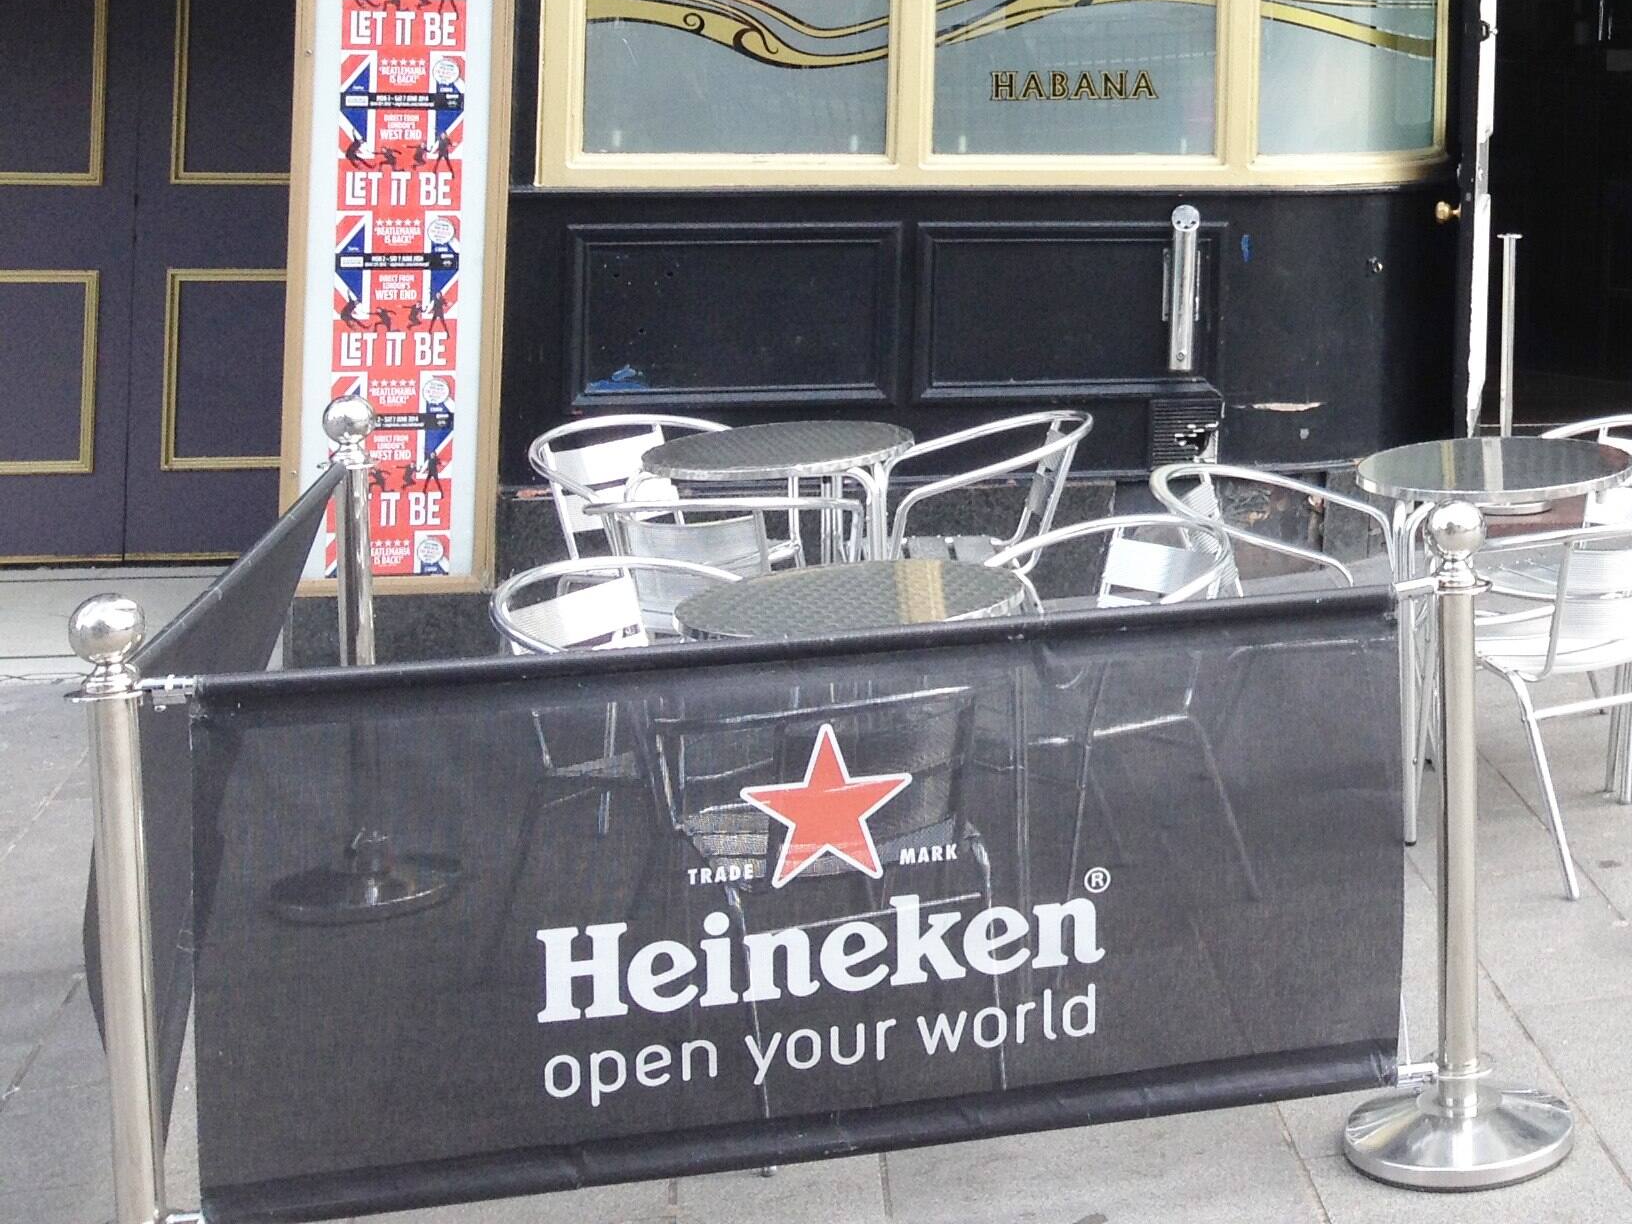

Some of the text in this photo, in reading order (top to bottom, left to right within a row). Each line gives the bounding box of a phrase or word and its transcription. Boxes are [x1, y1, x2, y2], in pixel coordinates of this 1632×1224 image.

[350, 10, 459, 46] LET IT BE
[990, 70, 1159, 101] HABANA
[380, 129, 422, 140] WEST END
[344, 171, 453, 206] LET IT BE
[375, 289, 418, 301] WEST END
[341, 331, 448, 366] LET IT BE
[369, 449, 412, 460] WEST END
[380, 491, 442, 527] IT BE
[688, 844, 958, 885] TRADE MARK
[536, 893, 1106, 1024] Heineken
[544, 983, 1097, 1108] open your world
